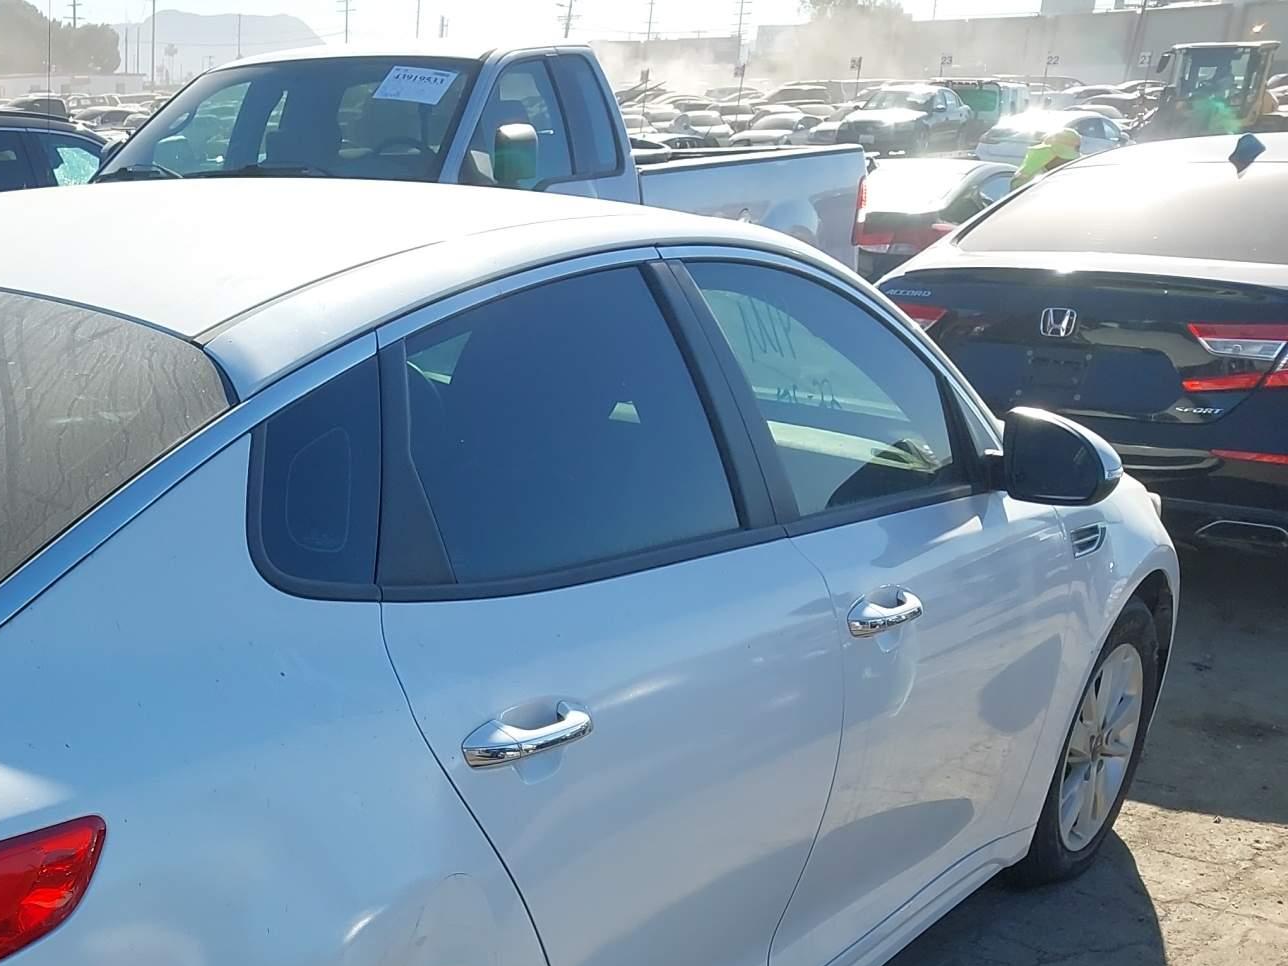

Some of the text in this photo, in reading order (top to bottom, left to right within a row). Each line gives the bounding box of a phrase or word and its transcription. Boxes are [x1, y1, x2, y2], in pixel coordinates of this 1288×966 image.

[1046, 55, 1060, 65] 22
[886, 288, 932, 297] ACCORD
[1175, 406, 1224, 415] SPORT
